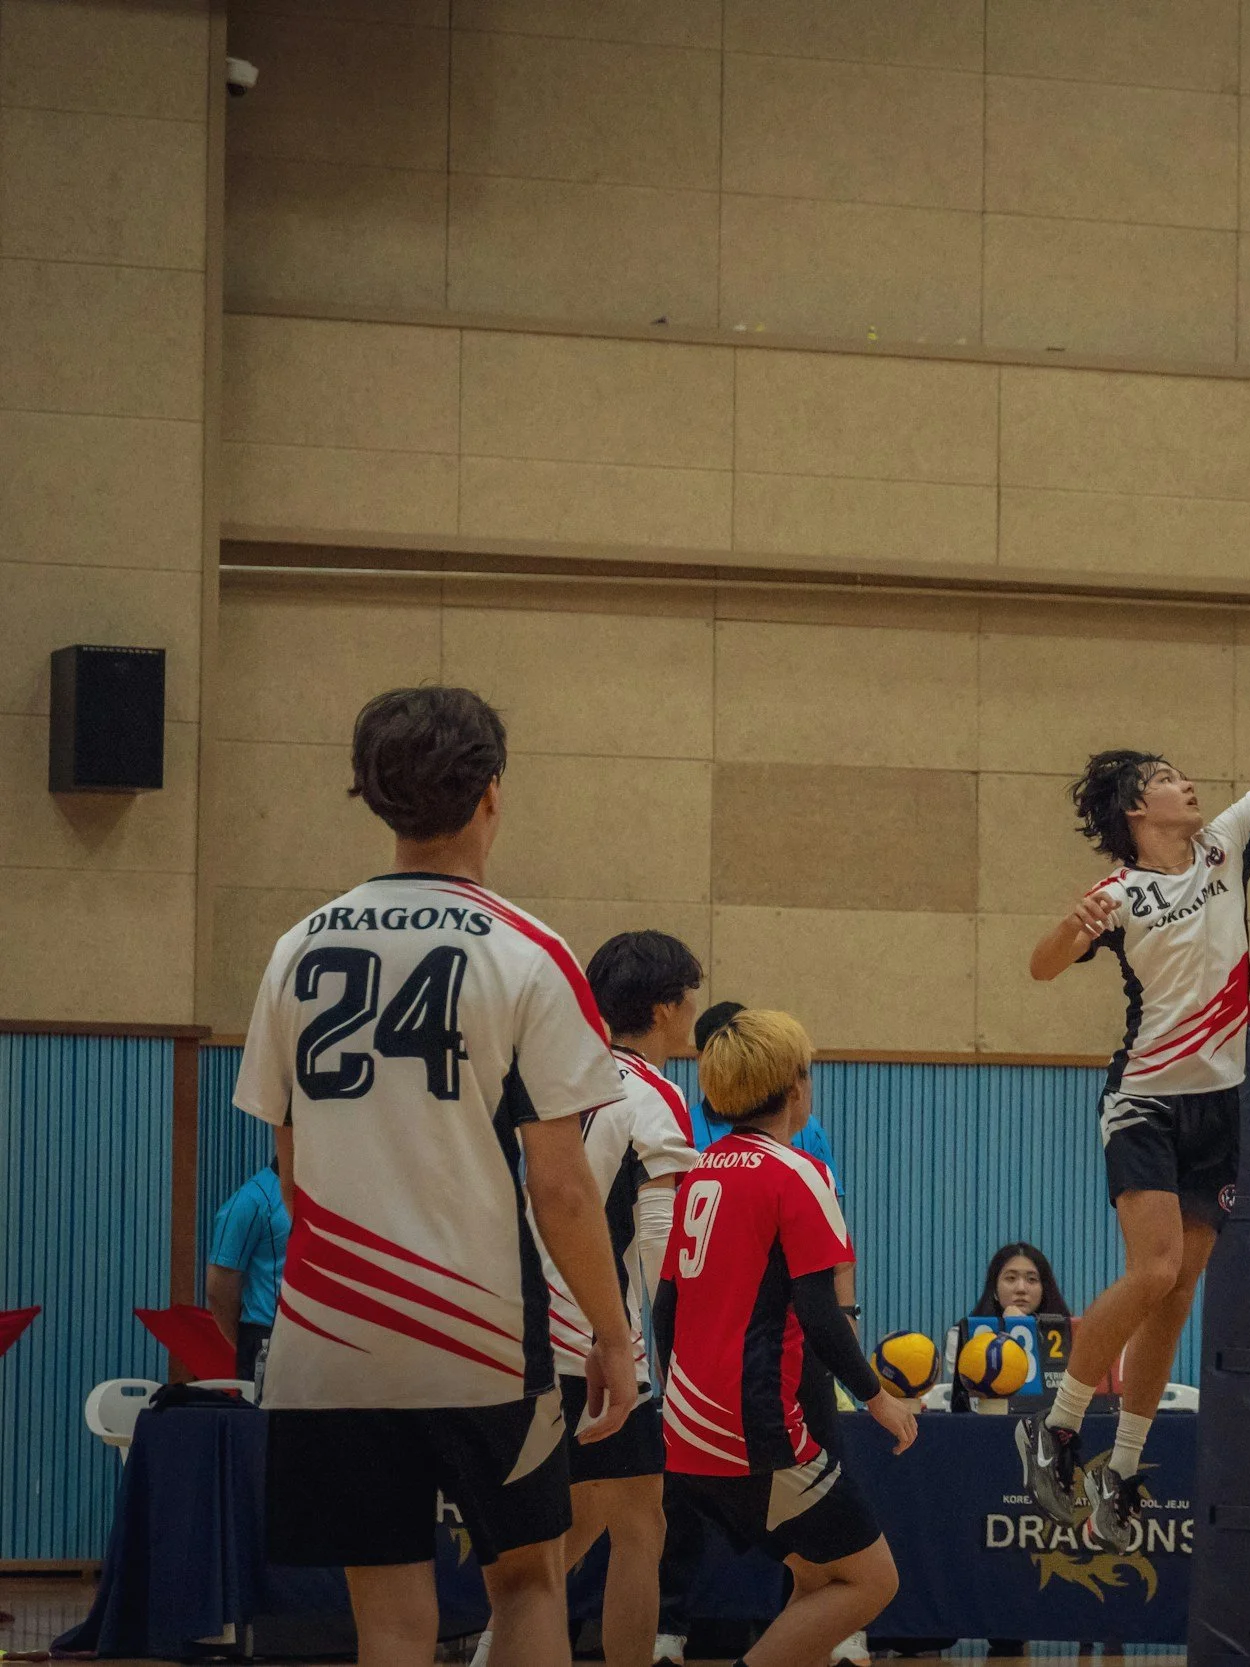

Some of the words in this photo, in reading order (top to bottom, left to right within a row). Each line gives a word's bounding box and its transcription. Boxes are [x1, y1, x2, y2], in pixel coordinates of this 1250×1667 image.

[1126, 881, 1170, 918] 21
[1147, 879, 1229, 931] OKOMA
[306, 907, 493, 936] DRAGONS
[294, 945, 469, 1101] 24
[688, 1152, 765, 1173] RAGONS
[679, 1179, 723, 1279] 9
[1047, 1329, 1064, 1358] 2
[1002, 1494, 1033, 1505] KORE
[1165, 1500, 1190, 1510] JEJU
